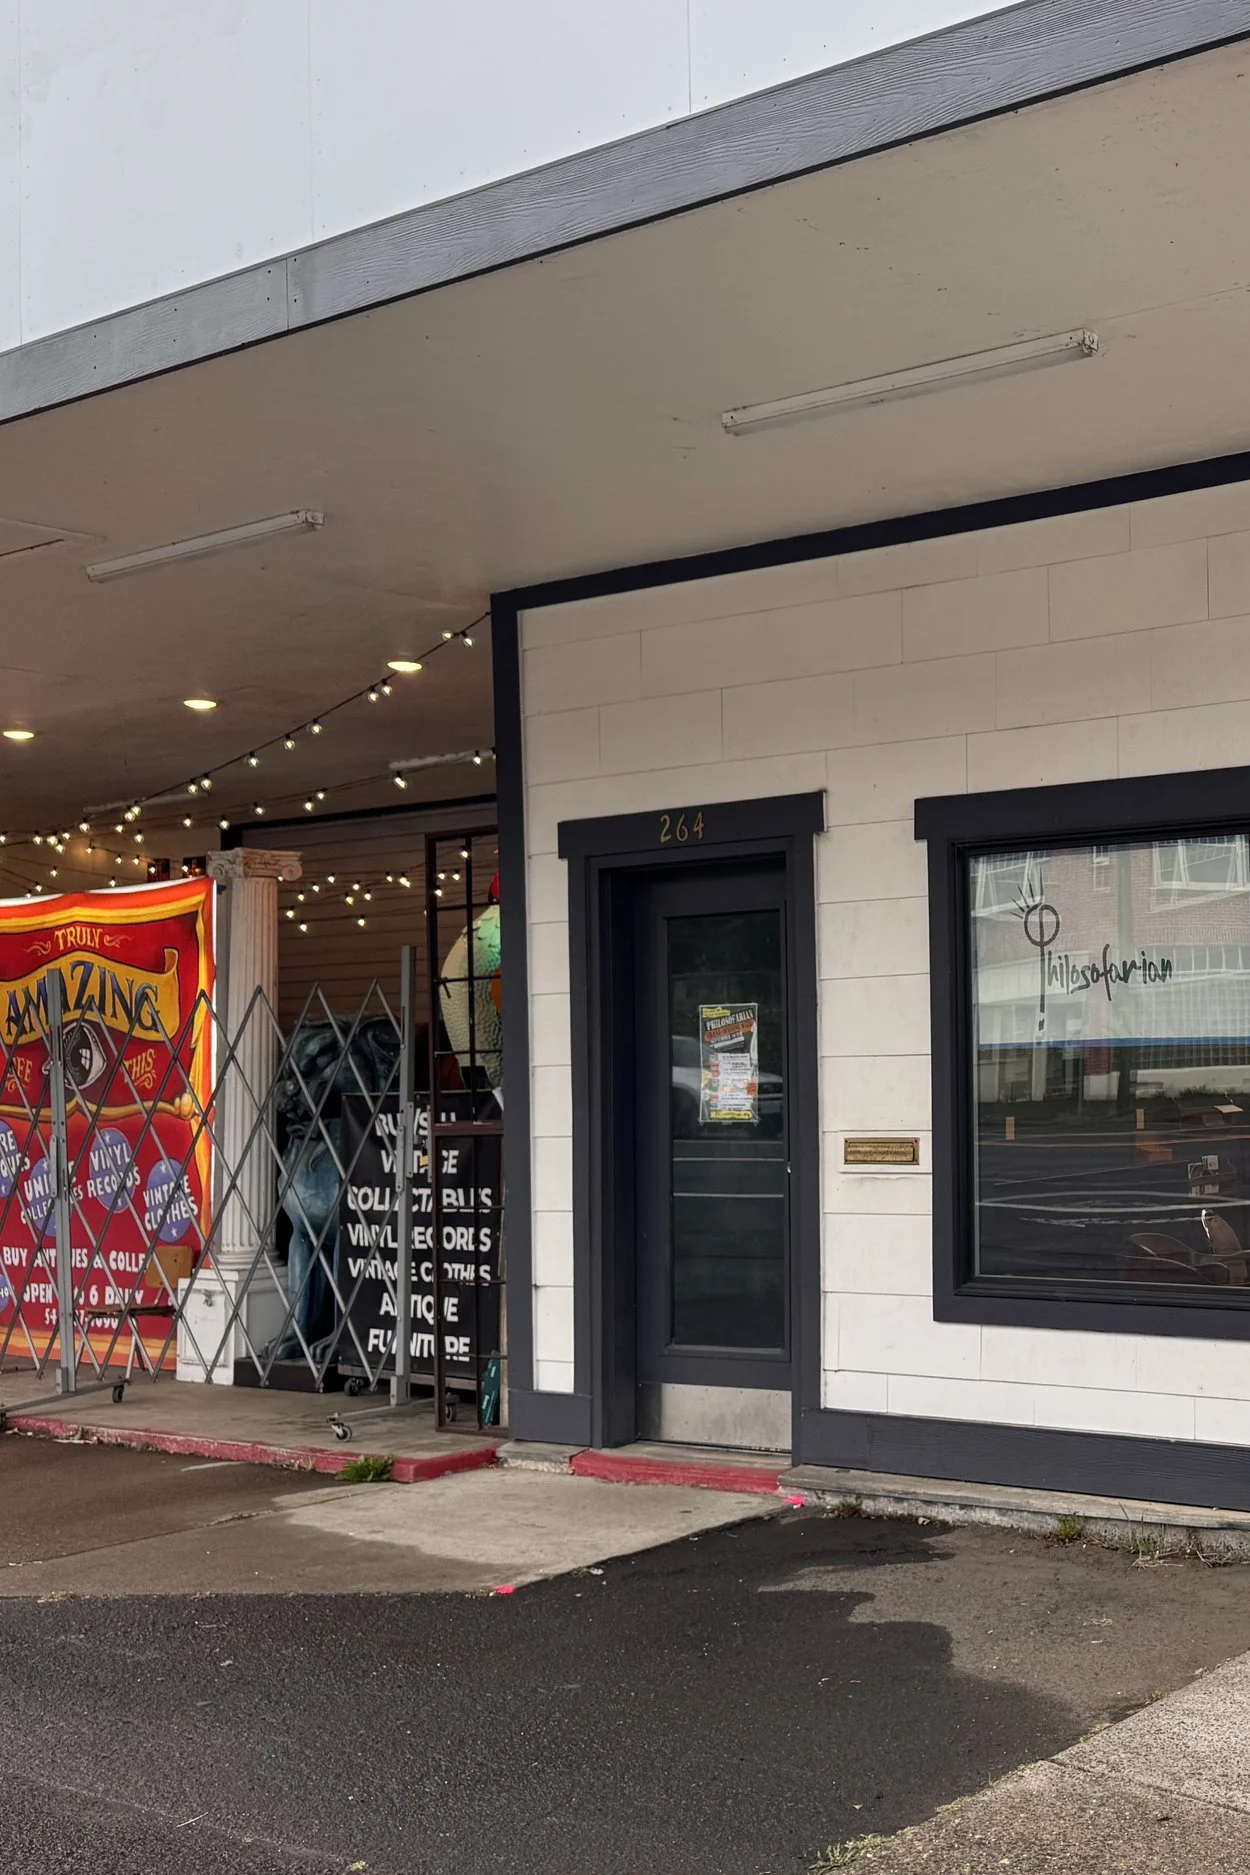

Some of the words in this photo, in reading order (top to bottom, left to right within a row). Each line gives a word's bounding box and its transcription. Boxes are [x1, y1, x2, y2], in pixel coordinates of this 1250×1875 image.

[660, 811, 704, 843] 264
[54, 926, 104, 951] TRULY
[3, 1247, 27, 1267] BUY
[89, 1285, 99, 1306] 6
